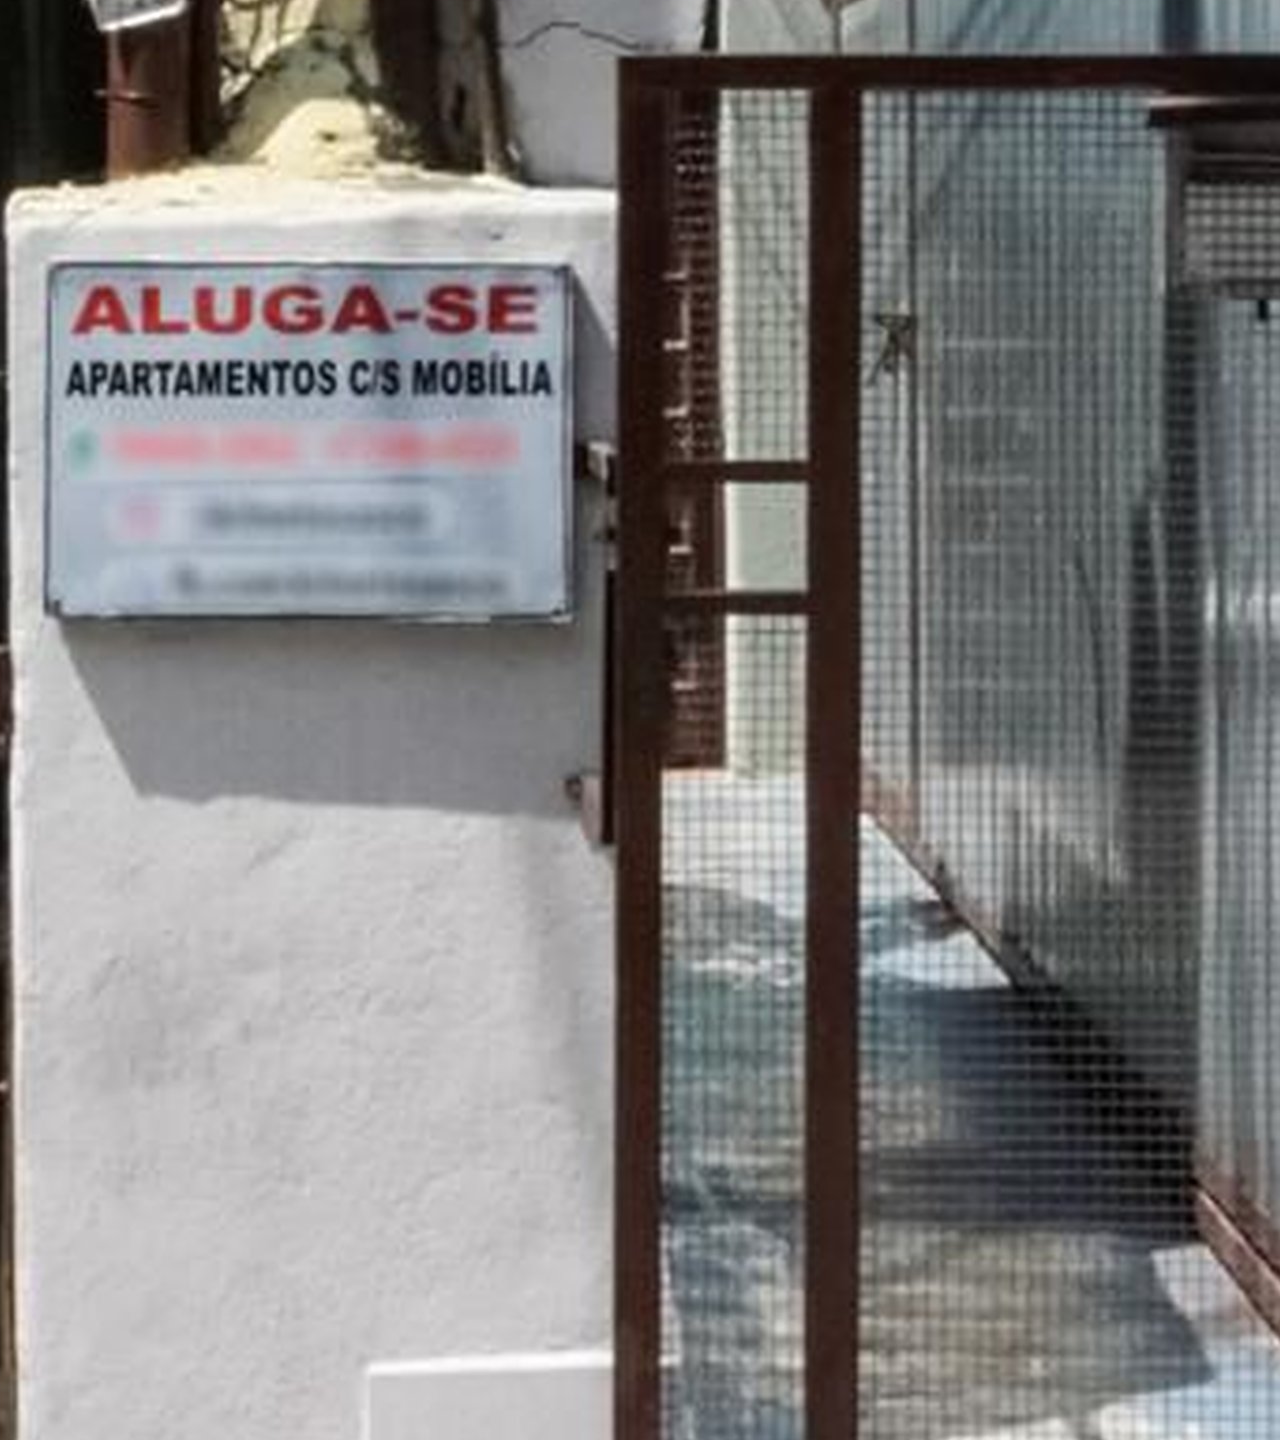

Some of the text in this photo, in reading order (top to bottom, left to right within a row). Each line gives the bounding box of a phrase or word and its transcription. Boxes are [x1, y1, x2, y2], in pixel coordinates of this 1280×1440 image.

[72, 284, 539, 335] ALUGA-SE
[66, 352, 553, 397] APARTAMENTOS C/S MOBÍLIA
